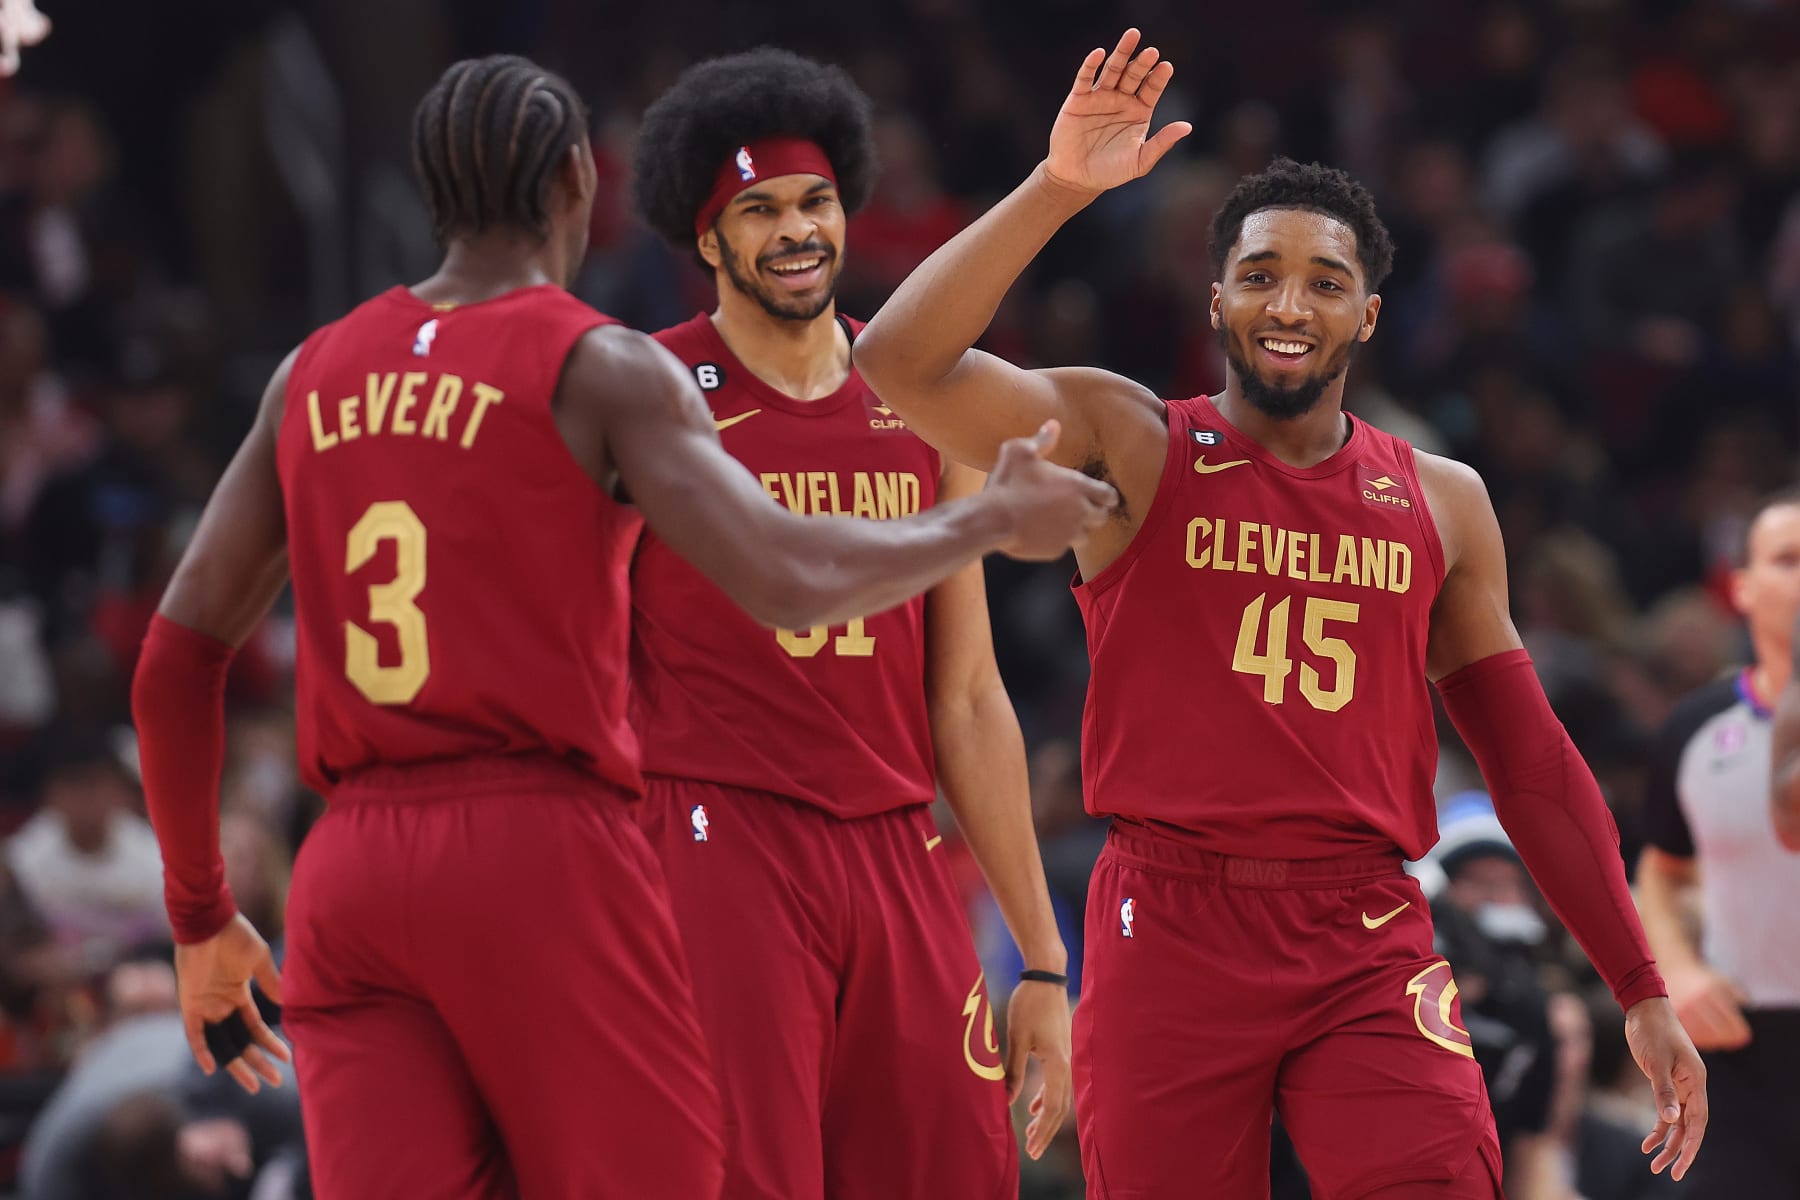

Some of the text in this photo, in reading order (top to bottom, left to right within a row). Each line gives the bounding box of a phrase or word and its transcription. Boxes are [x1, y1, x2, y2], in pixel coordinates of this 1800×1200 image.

[697, 365, 719, 389] 6
[869, 419, 907, 430] CLIFF
[1195, 431, 1215, 445] 6
[760, 471, 920, 521] EVELAND
[1363, 489, 1410, 508] CLIFFS
[1185, 517, 1412, 594] CLEVELAND
[345, 500, 431, 706] 3
[1231, 592, 1360, 713] 45
